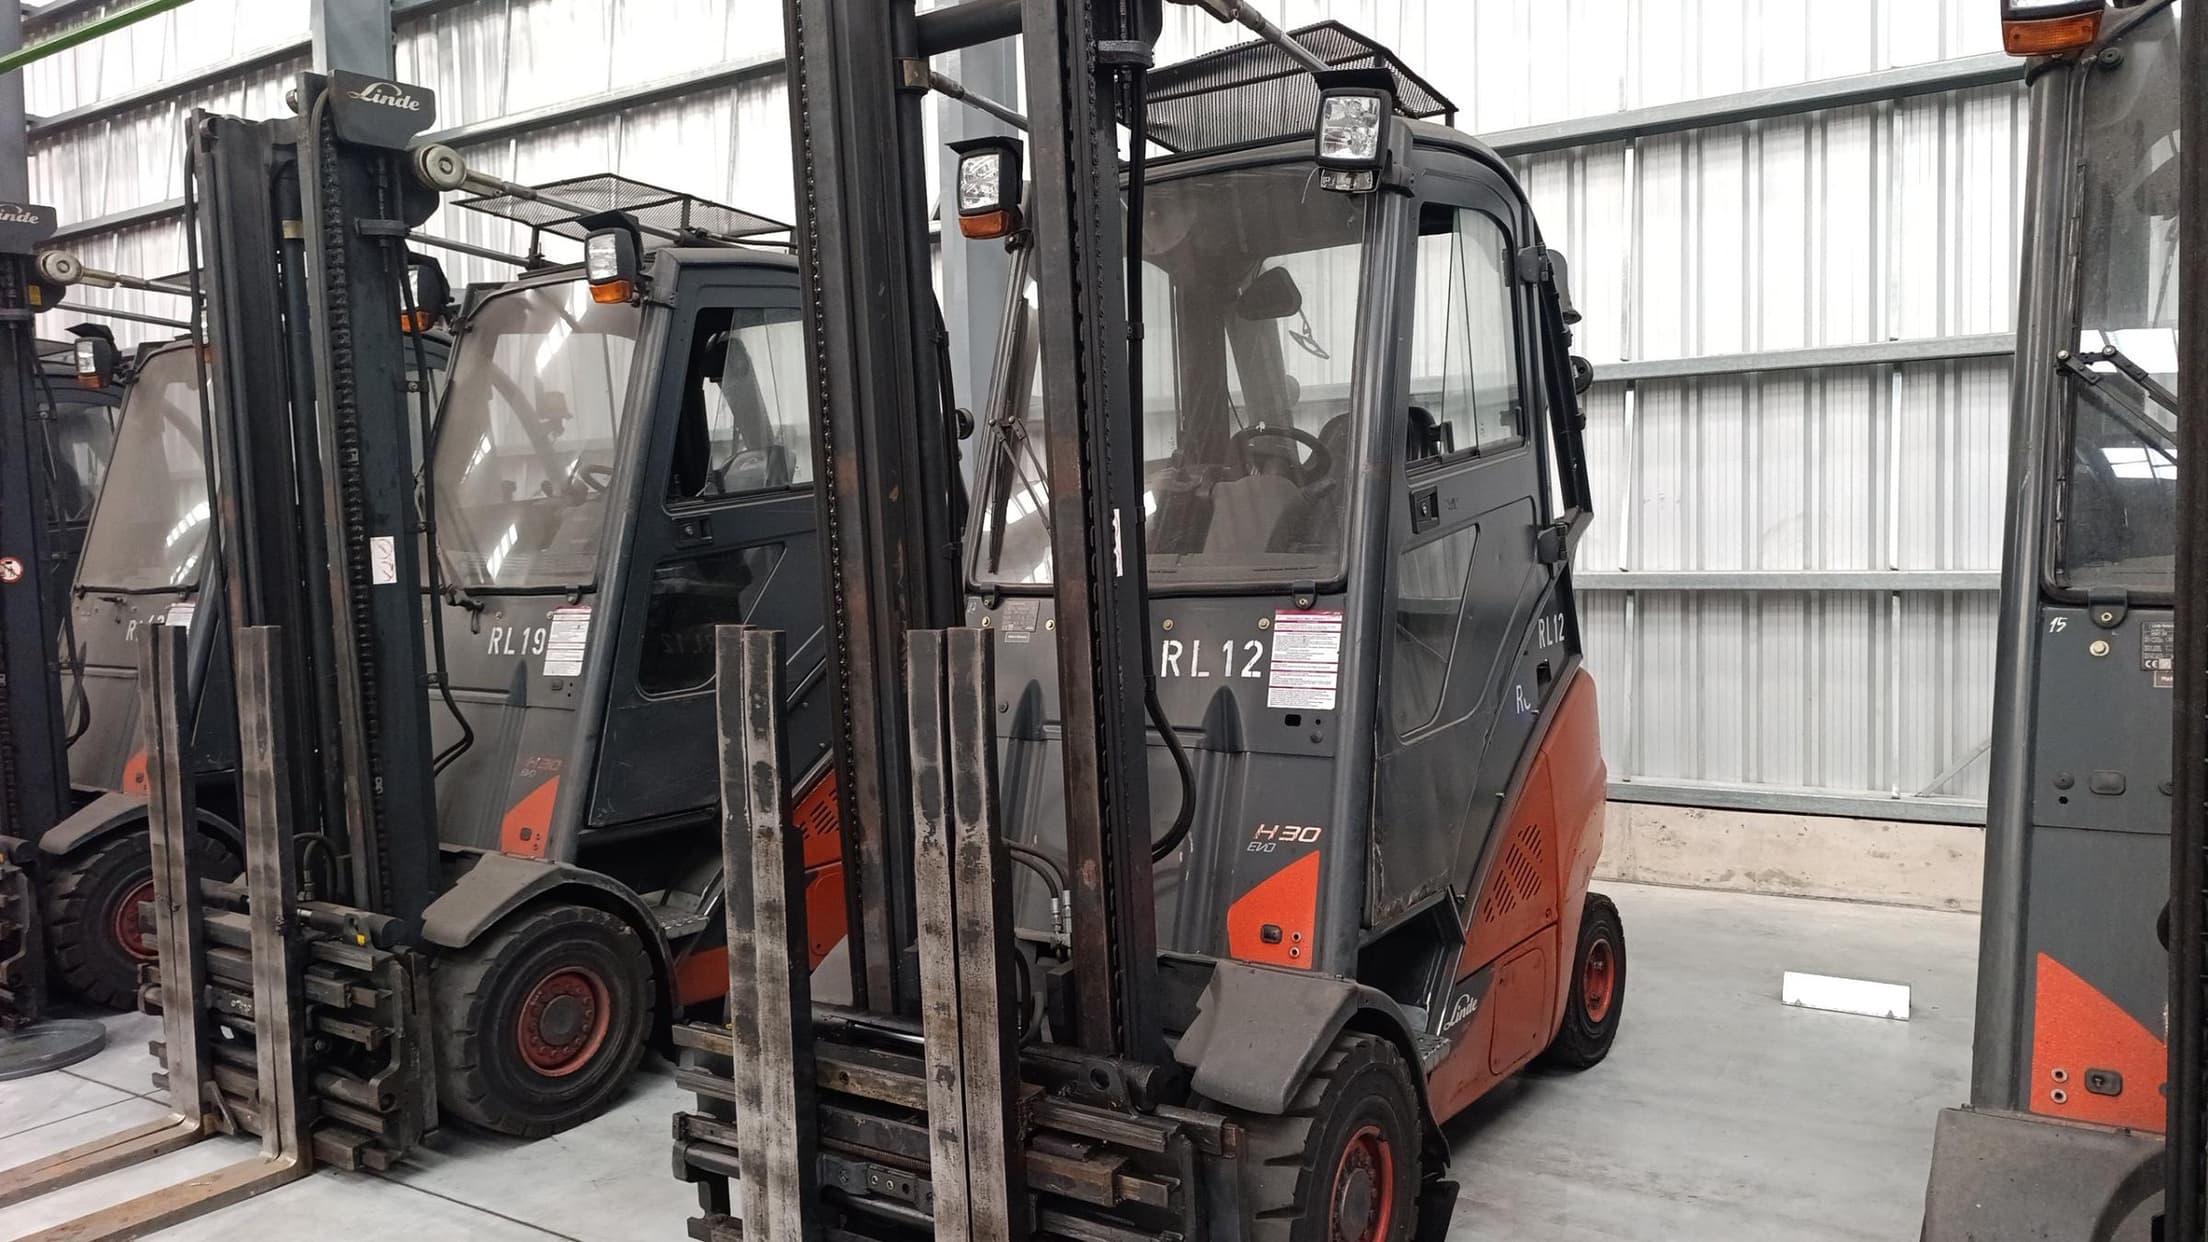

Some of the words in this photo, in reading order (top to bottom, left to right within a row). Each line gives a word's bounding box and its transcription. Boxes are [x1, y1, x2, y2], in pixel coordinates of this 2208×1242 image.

[346, 82, 420, 111] Linde
[1536, 613, 1565, 649] RL12
[2049, 616, 2068, 632] 15
[487, 627, 546, 655] RL19
[1161, 640, 1264, 677] RL12
[1246, 841, 1277, 853] EVO
[1254, 824, 1322, 842] H30
[1443, 993, 1478, 1031] Linde
